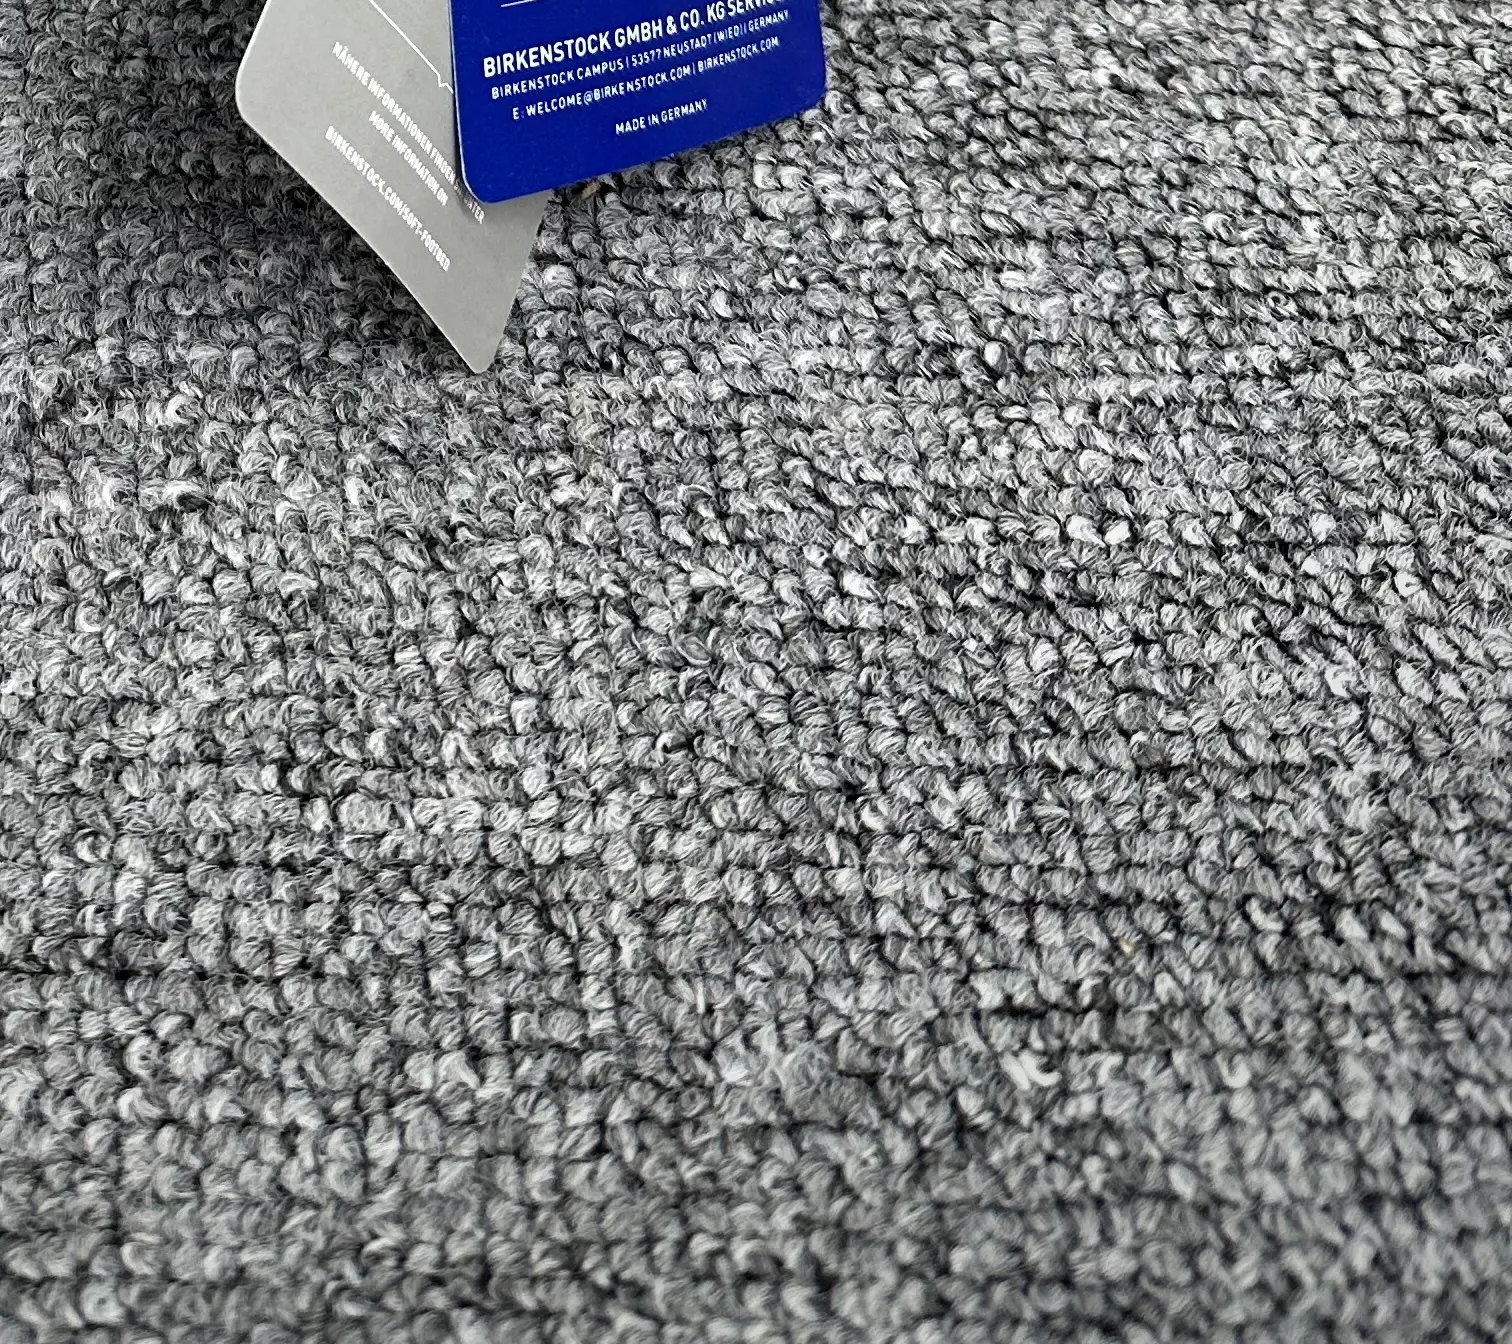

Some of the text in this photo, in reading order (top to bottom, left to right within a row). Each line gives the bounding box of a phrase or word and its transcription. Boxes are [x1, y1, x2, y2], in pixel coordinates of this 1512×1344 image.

[483, 30, 612, 79] BIRKENSTOCK
[614, 18, 664, 48] GMBH
[666, 15, 678, 35] &
[679, 9, 705, 31] CO.
[706, 0, 727, 23] KG
[491, 69, 575, 100] BIRKENSTOCK
[576, 57, 624, 81] CAMPUS
[631, 48, 662, 67] 53577
[663, 33, 712, 58] NEUSTADT
[748, 9, 789, 33] GERMANY
[525, 64, 691, 117] WELCOME@BIRKENSTOCK.COM
[697, 36, 780, 73] BIRKENSTOCK.COM
[367, 77, 433, 155] INFORMATIONEN
[429, 147, 457, 185] FINDEN
[369, 110, 449, 207] MORE INFORMATION ON
[615, 99, 708, 135] MADE IN GERMANY
[325, 125, 451, 272] BIRKENSTOCK.COM/SOFT-FOOTBED
